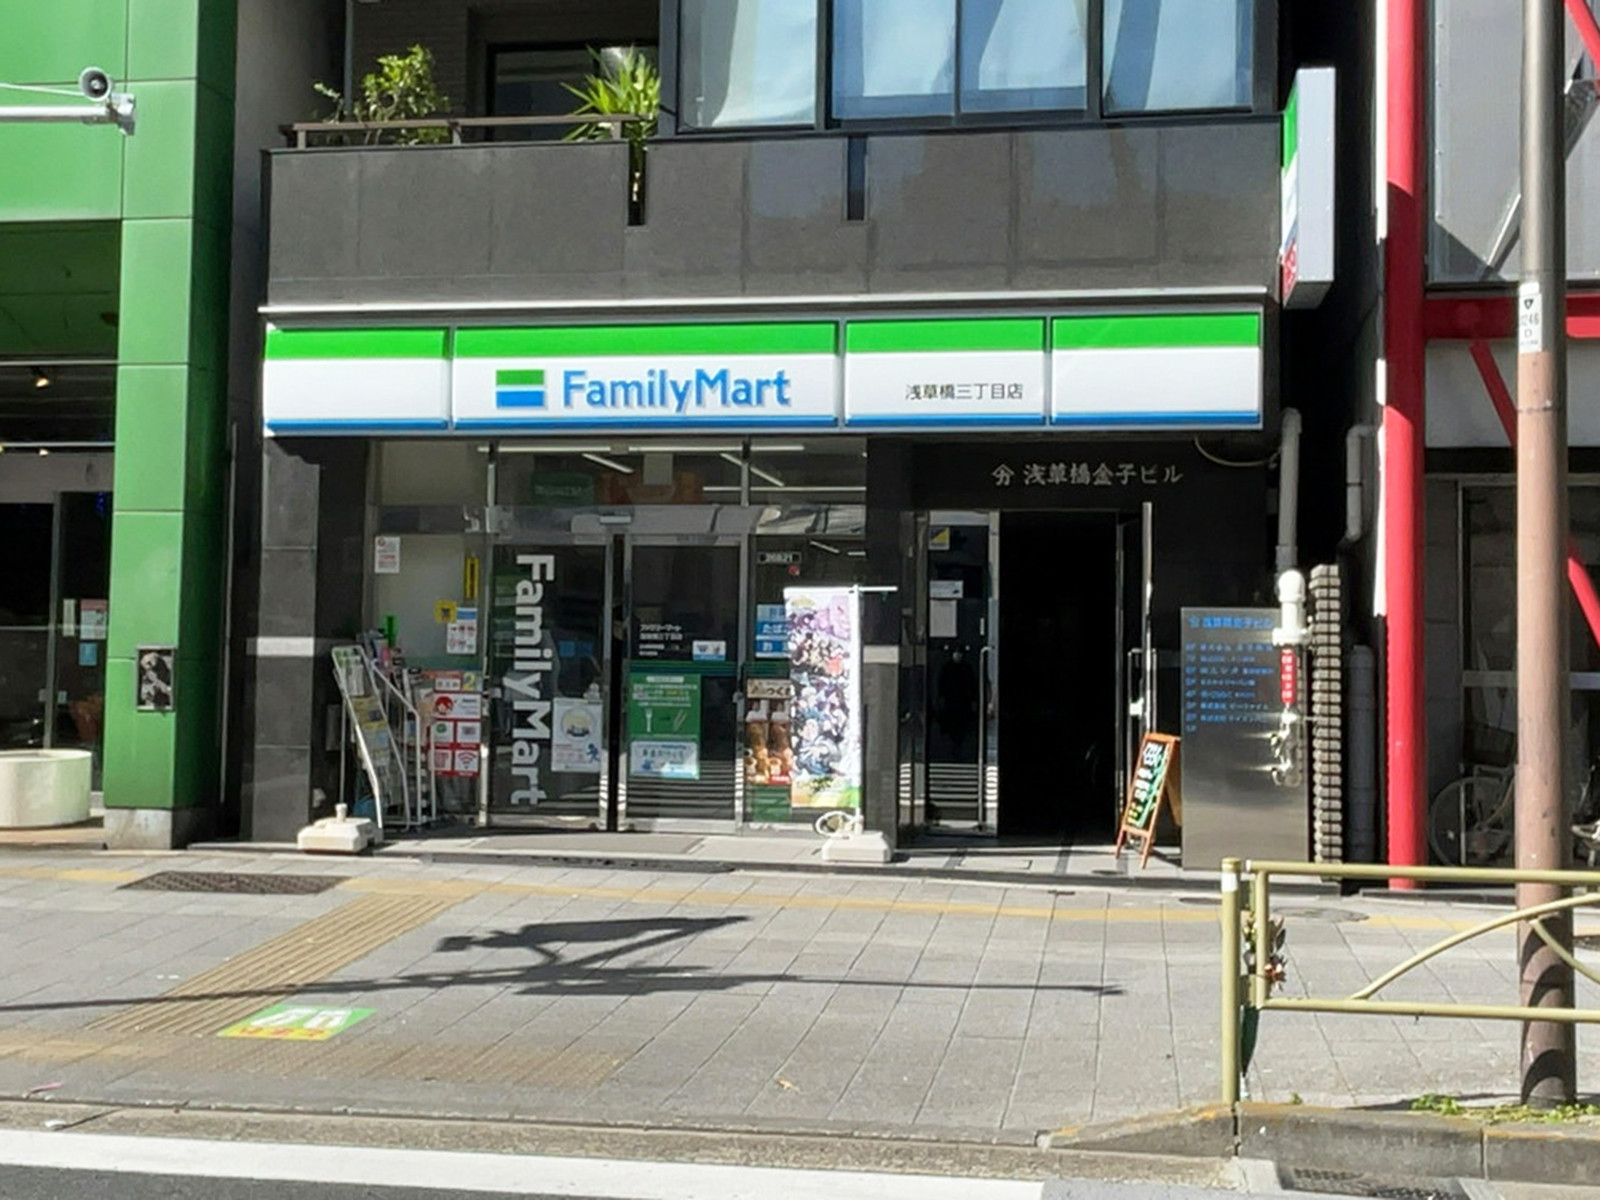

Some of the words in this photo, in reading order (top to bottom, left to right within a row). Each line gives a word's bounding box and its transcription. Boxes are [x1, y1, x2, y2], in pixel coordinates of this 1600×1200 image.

[563, 368, 791, 412] FamilyMart
[905, 383, 1024, 401] 浅草橋三丁目店
[1023, 463, 1184, 486] 浅草橋金子ビル
[503, 554, 555, 805] FamilyMart
